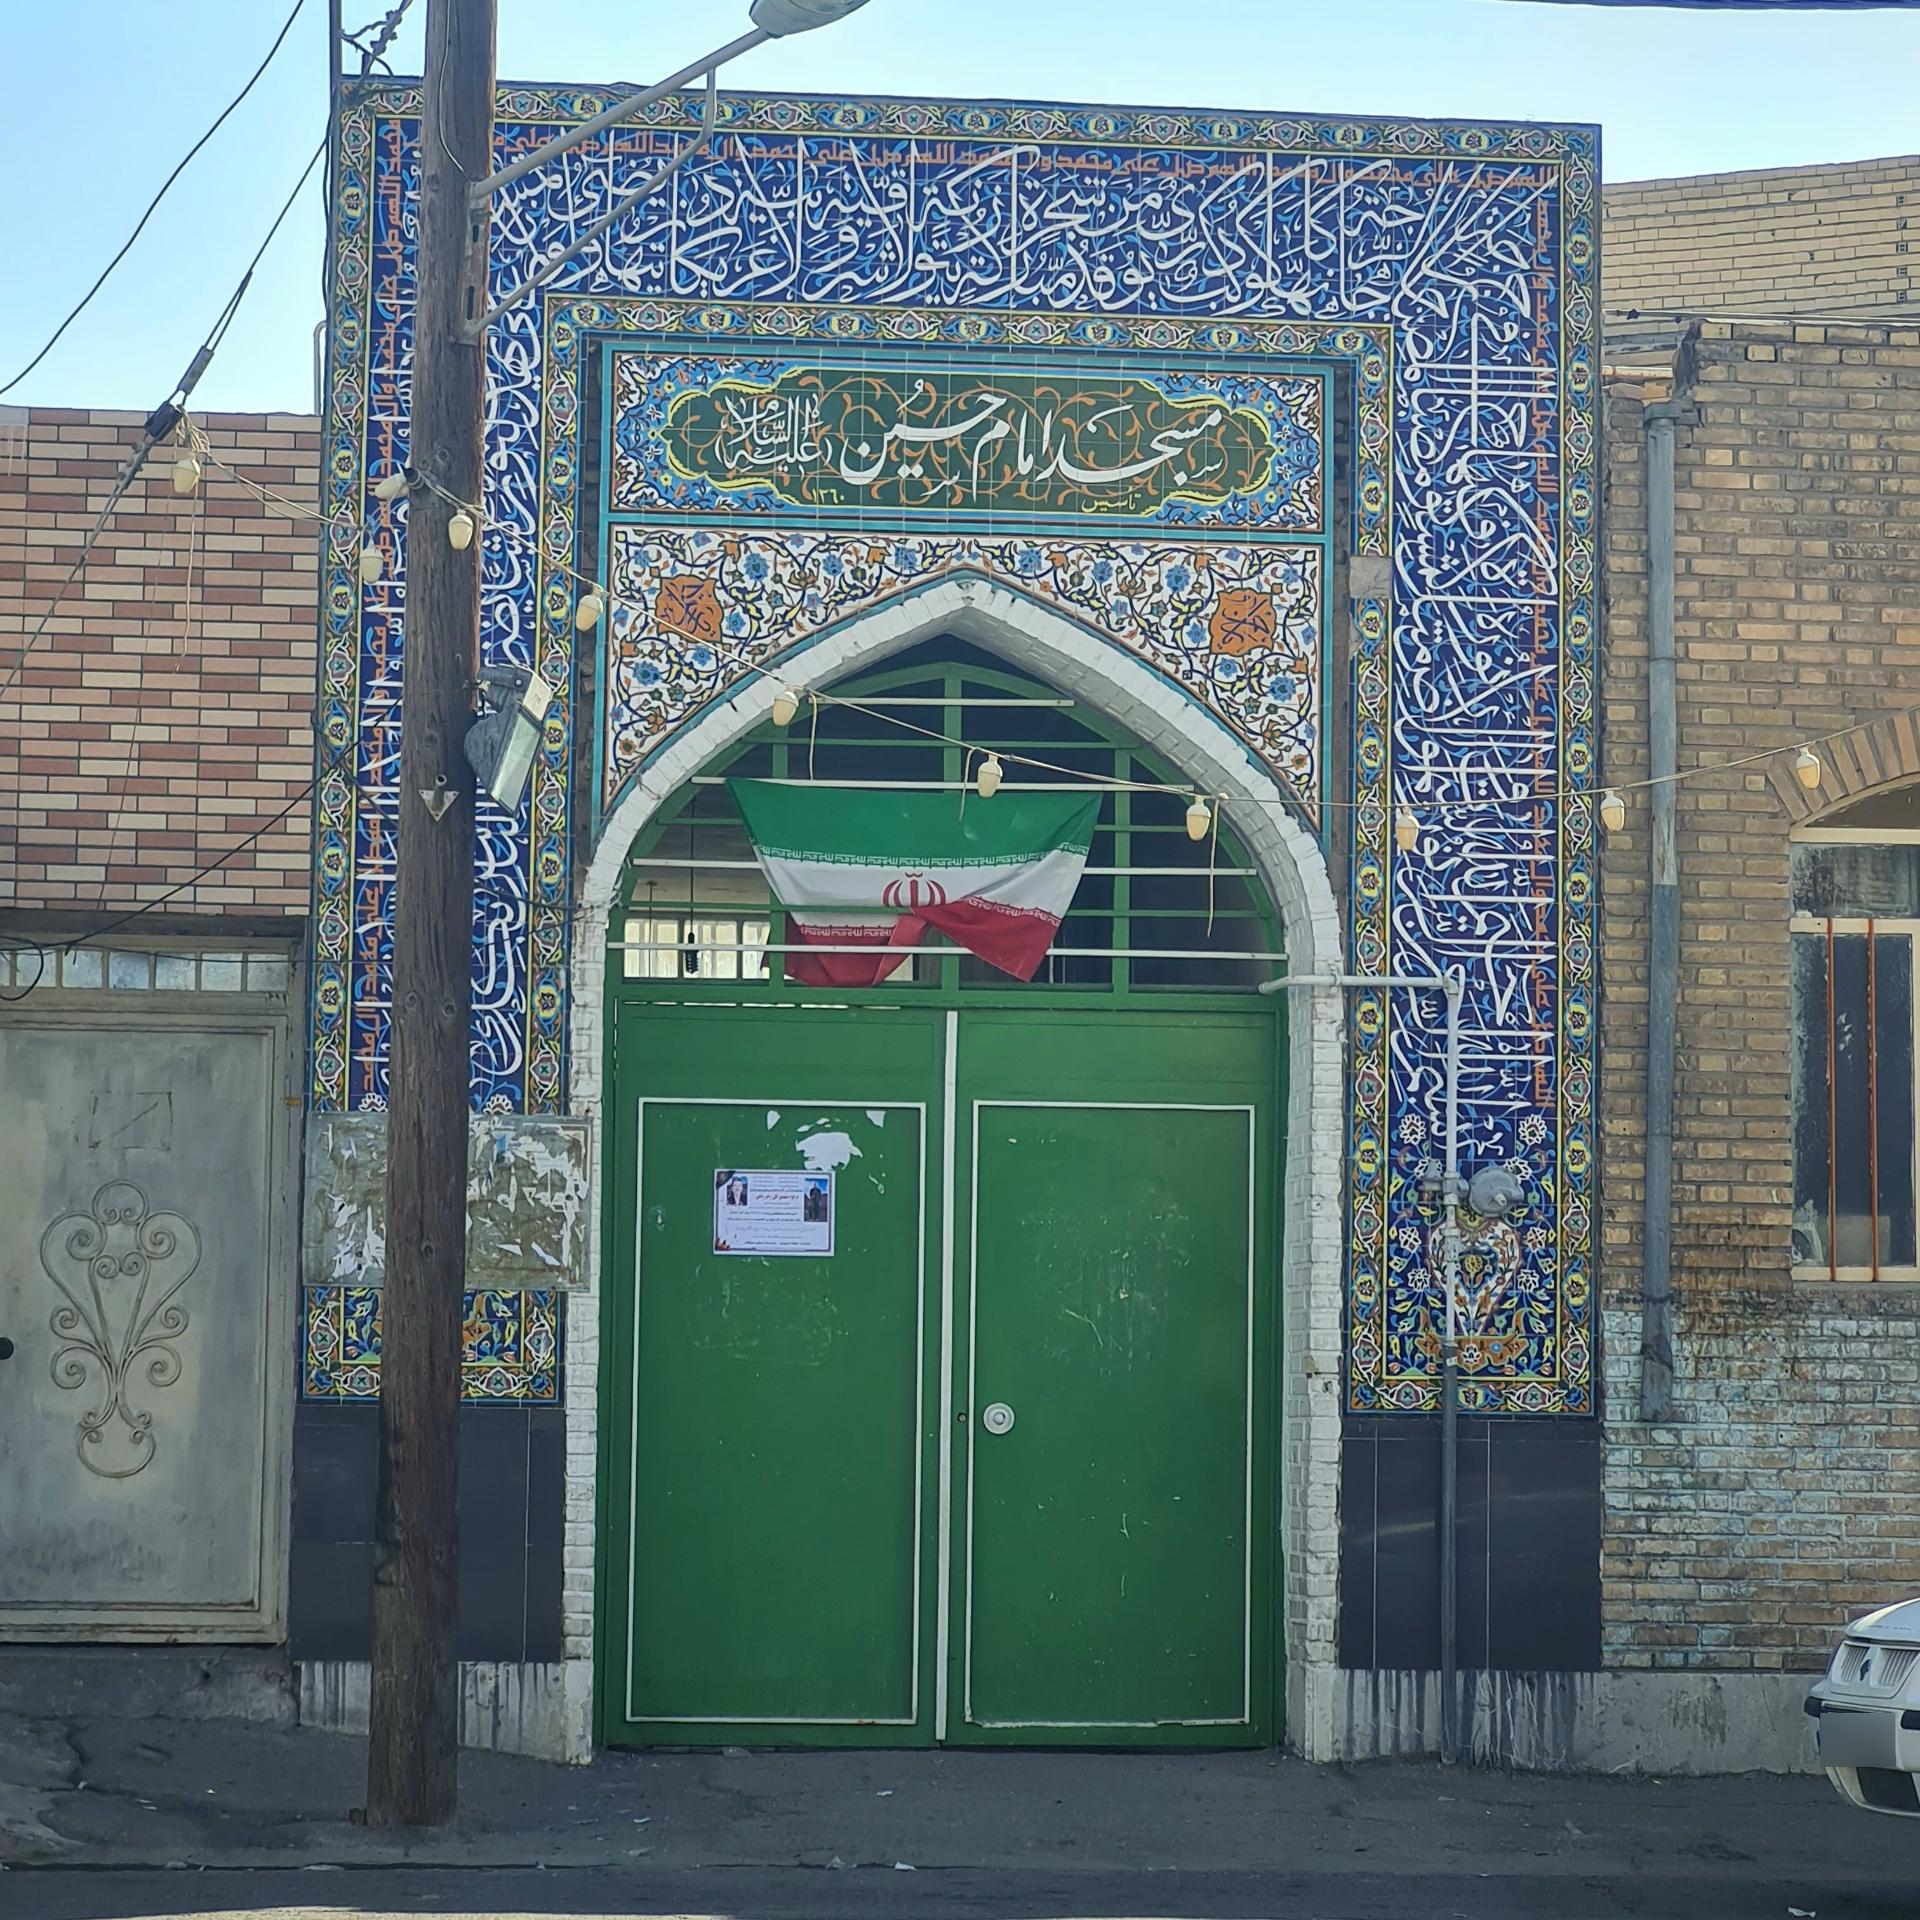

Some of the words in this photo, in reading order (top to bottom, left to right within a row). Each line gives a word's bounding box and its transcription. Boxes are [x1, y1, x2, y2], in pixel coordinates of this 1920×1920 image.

[840, 393, 1007, 485] حسین
[972, 409, 1053, 502] امام
[1036, 406, 1222, 486] مسجد
